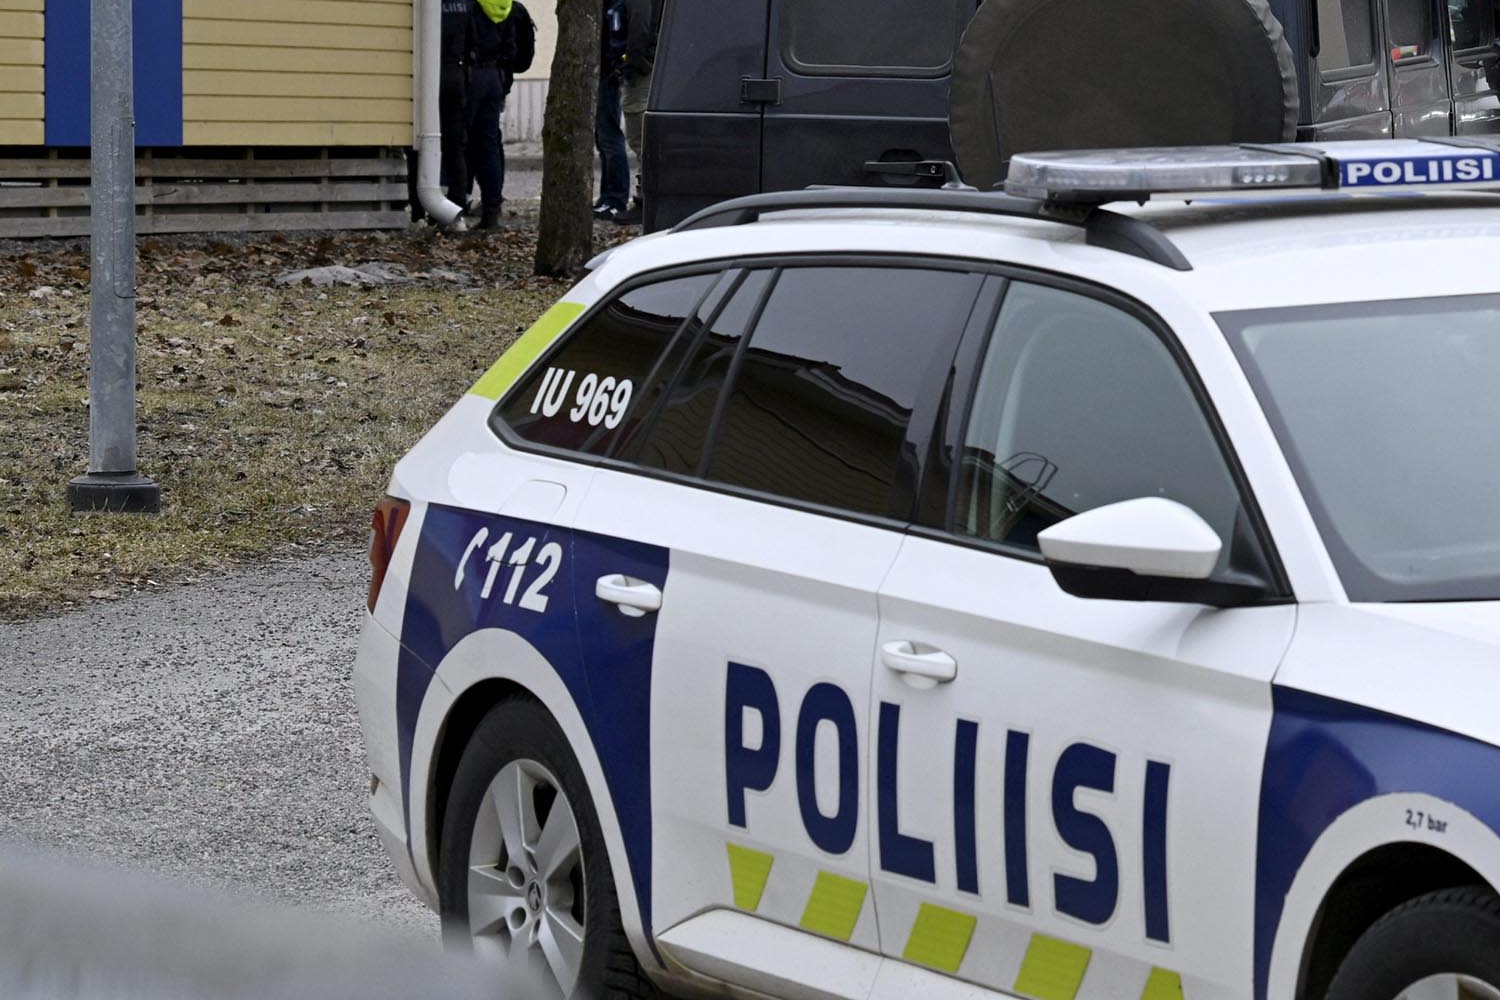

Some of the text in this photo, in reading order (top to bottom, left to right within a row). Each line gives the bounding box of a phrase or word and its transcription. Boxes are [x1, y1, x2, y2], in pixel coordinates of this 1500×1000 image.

[442, 2, 467, 12] LIISI
[1346, 157, 1493, 185] POLIISI
[529, 366, 633, 430] IU 969
[480, 531, 563, 613] 112
[725, 660, 1171, 944] POLIISI
